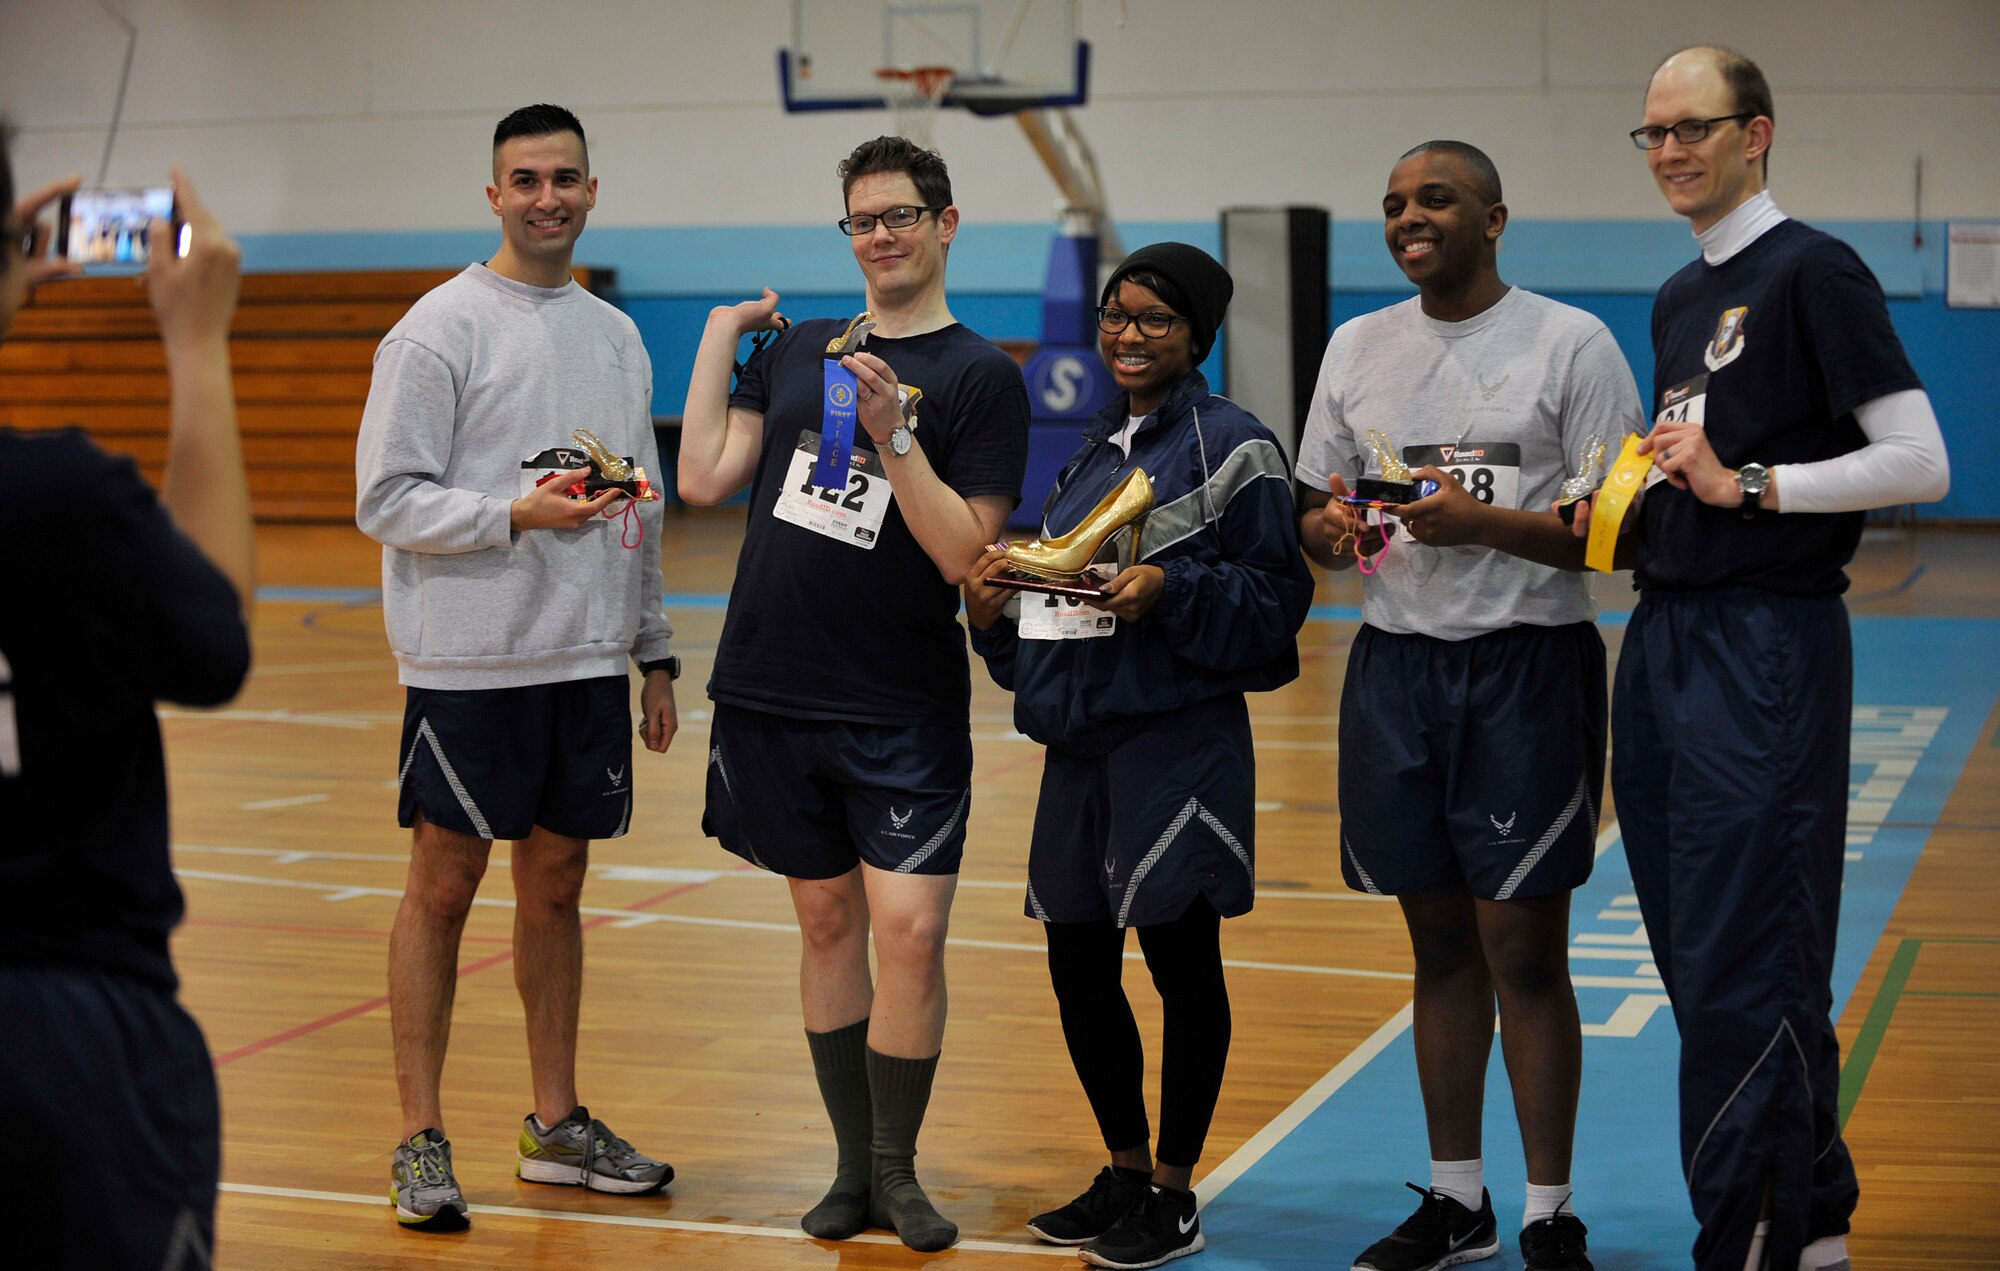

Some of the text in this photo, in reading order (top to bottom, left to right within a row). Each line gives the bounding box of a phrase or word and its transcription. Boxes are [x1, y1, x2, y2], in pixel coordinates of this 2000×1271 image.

[1043, 357, 1084, 411] S
[830, 410, 852, 418] FIRST
[850, 454, 866, 464] adID
[806, 498, 848, 519] RoadID.com
